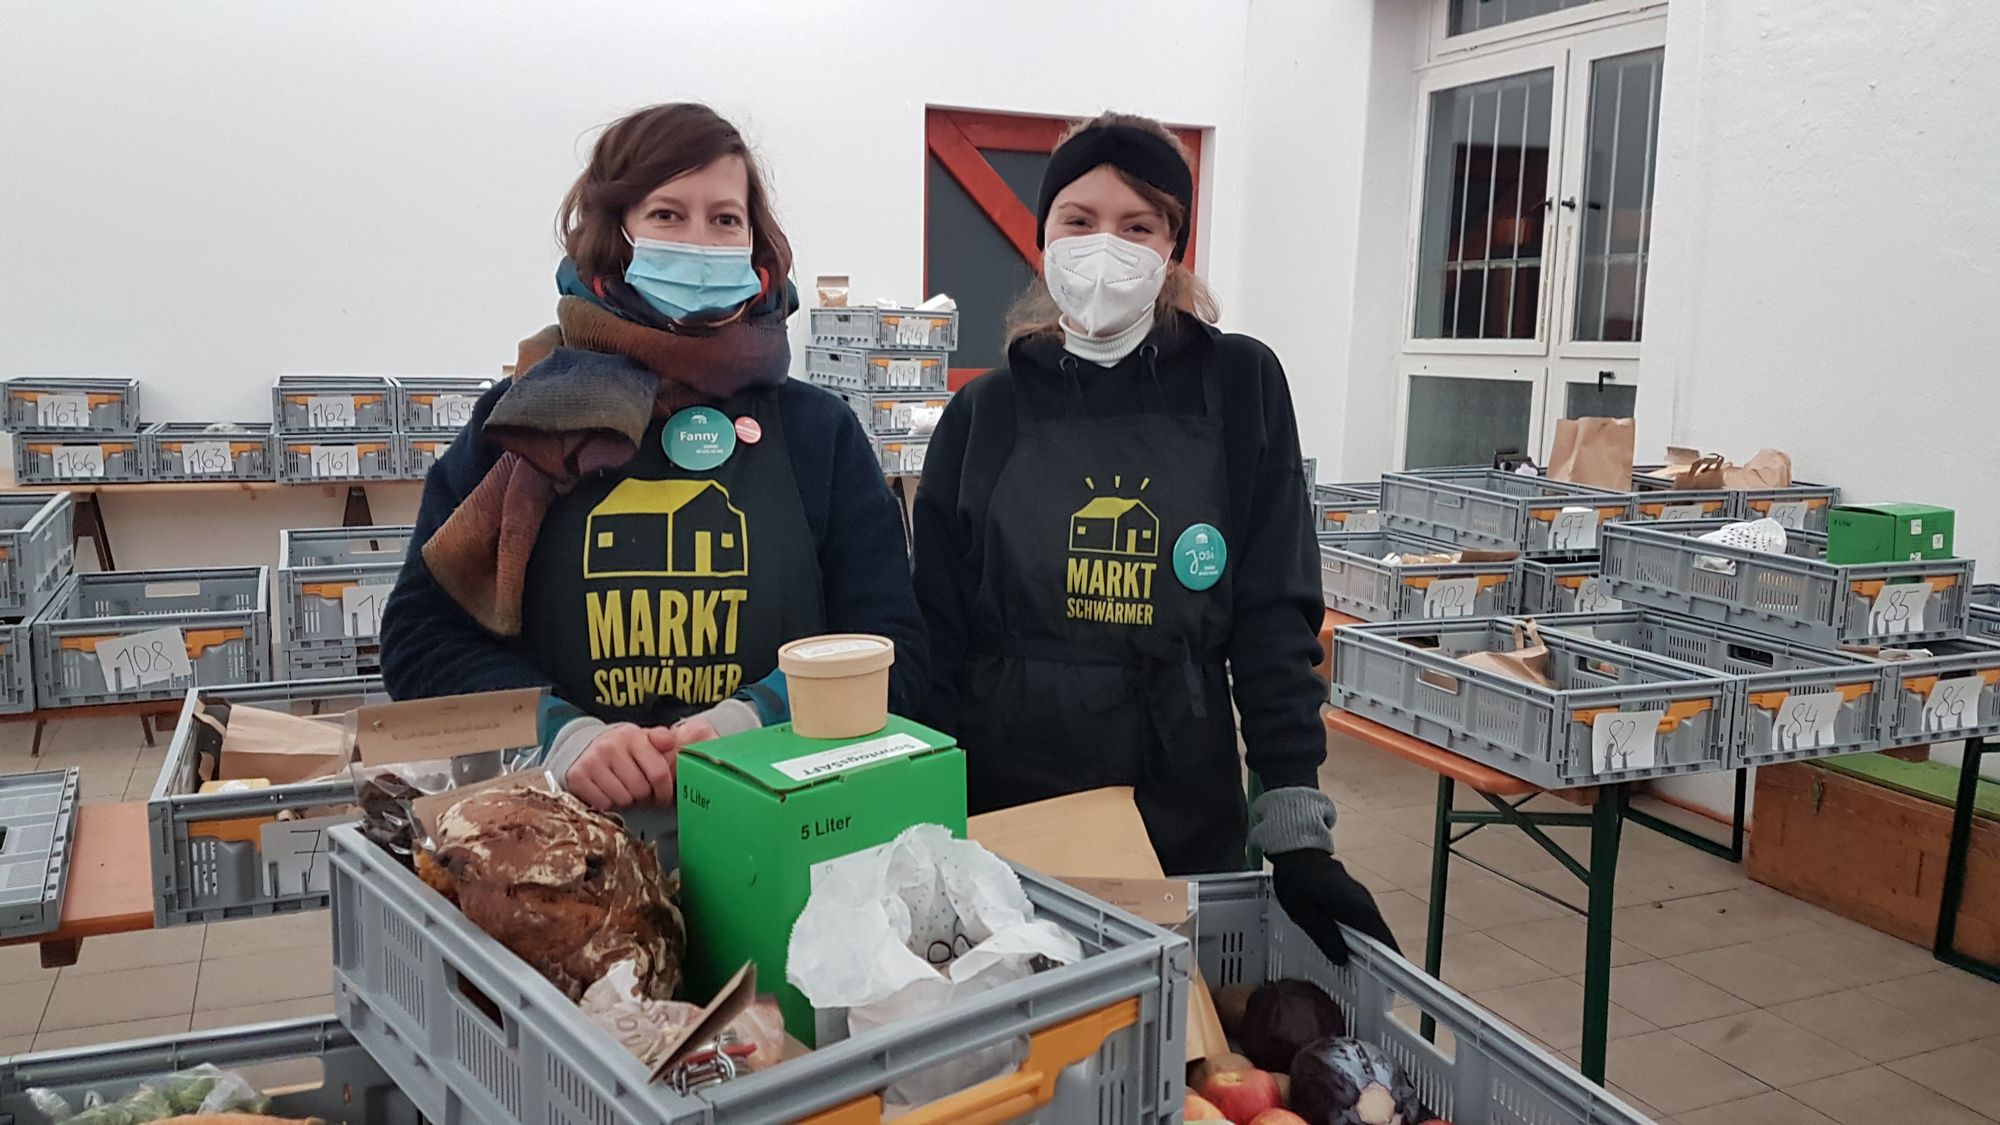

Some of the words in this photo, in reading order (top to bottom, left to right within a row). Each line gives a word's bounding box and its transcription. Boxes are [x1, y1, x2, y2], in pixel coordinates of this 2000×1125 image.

[44, 401, 78, 423] 167
[313, 403, 346, 423] 162
[437, 402, 473, 422] 159
[680, 431, 719, 443] Fanny
[57, 451, 96, 472] 166
[189, 449, 226, 470] 163
[319, 452, 349, 473] 161
[1561, 514, 1585, 543] 97
[1775, 506, 1797, 528] 93
[1185, 546, 1215, 575] Josi
[1066, 558, 1157, 599] MARKT
[1432, 585, 1465, 609] 102
[1884, 590, 1920, 622] 85
[1067, 597, 1154, 625] SCHWÄRMER
[586, 589, 747, 660] MARKT
[115, 641, 173, 675] 108
[593, 659, 743, 707] SCHWÄRMER
[1934, 686, 1965, 718] 86
[1787, 702, 1819, 739] 84
[1604, 719, 1636, 759] 82
[683, 785, 689, 799] 5
[690, 789, 711, 810] Liter
[801, 825, 810, 841] 5
[815, 816, 852, 837] Liter
